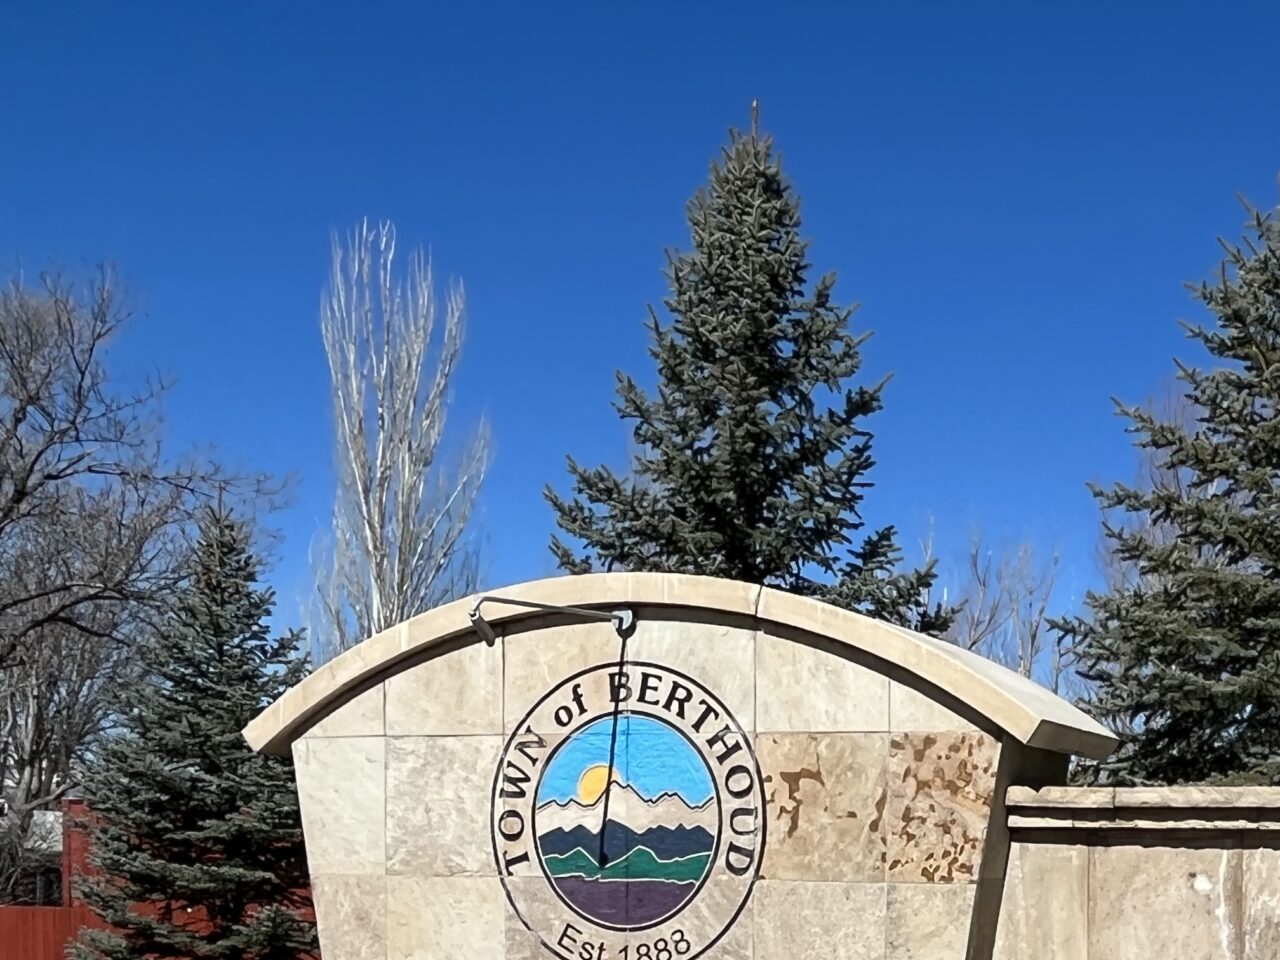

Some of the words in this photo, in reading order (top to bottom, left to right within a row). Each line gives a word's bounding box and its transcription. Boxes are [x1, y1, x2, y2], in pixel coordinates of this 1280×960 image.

[498, 725, 547, 877] TOWN
[554, 683, 588, 727] of
[608, 672, 758, 877] BERTHOUD
